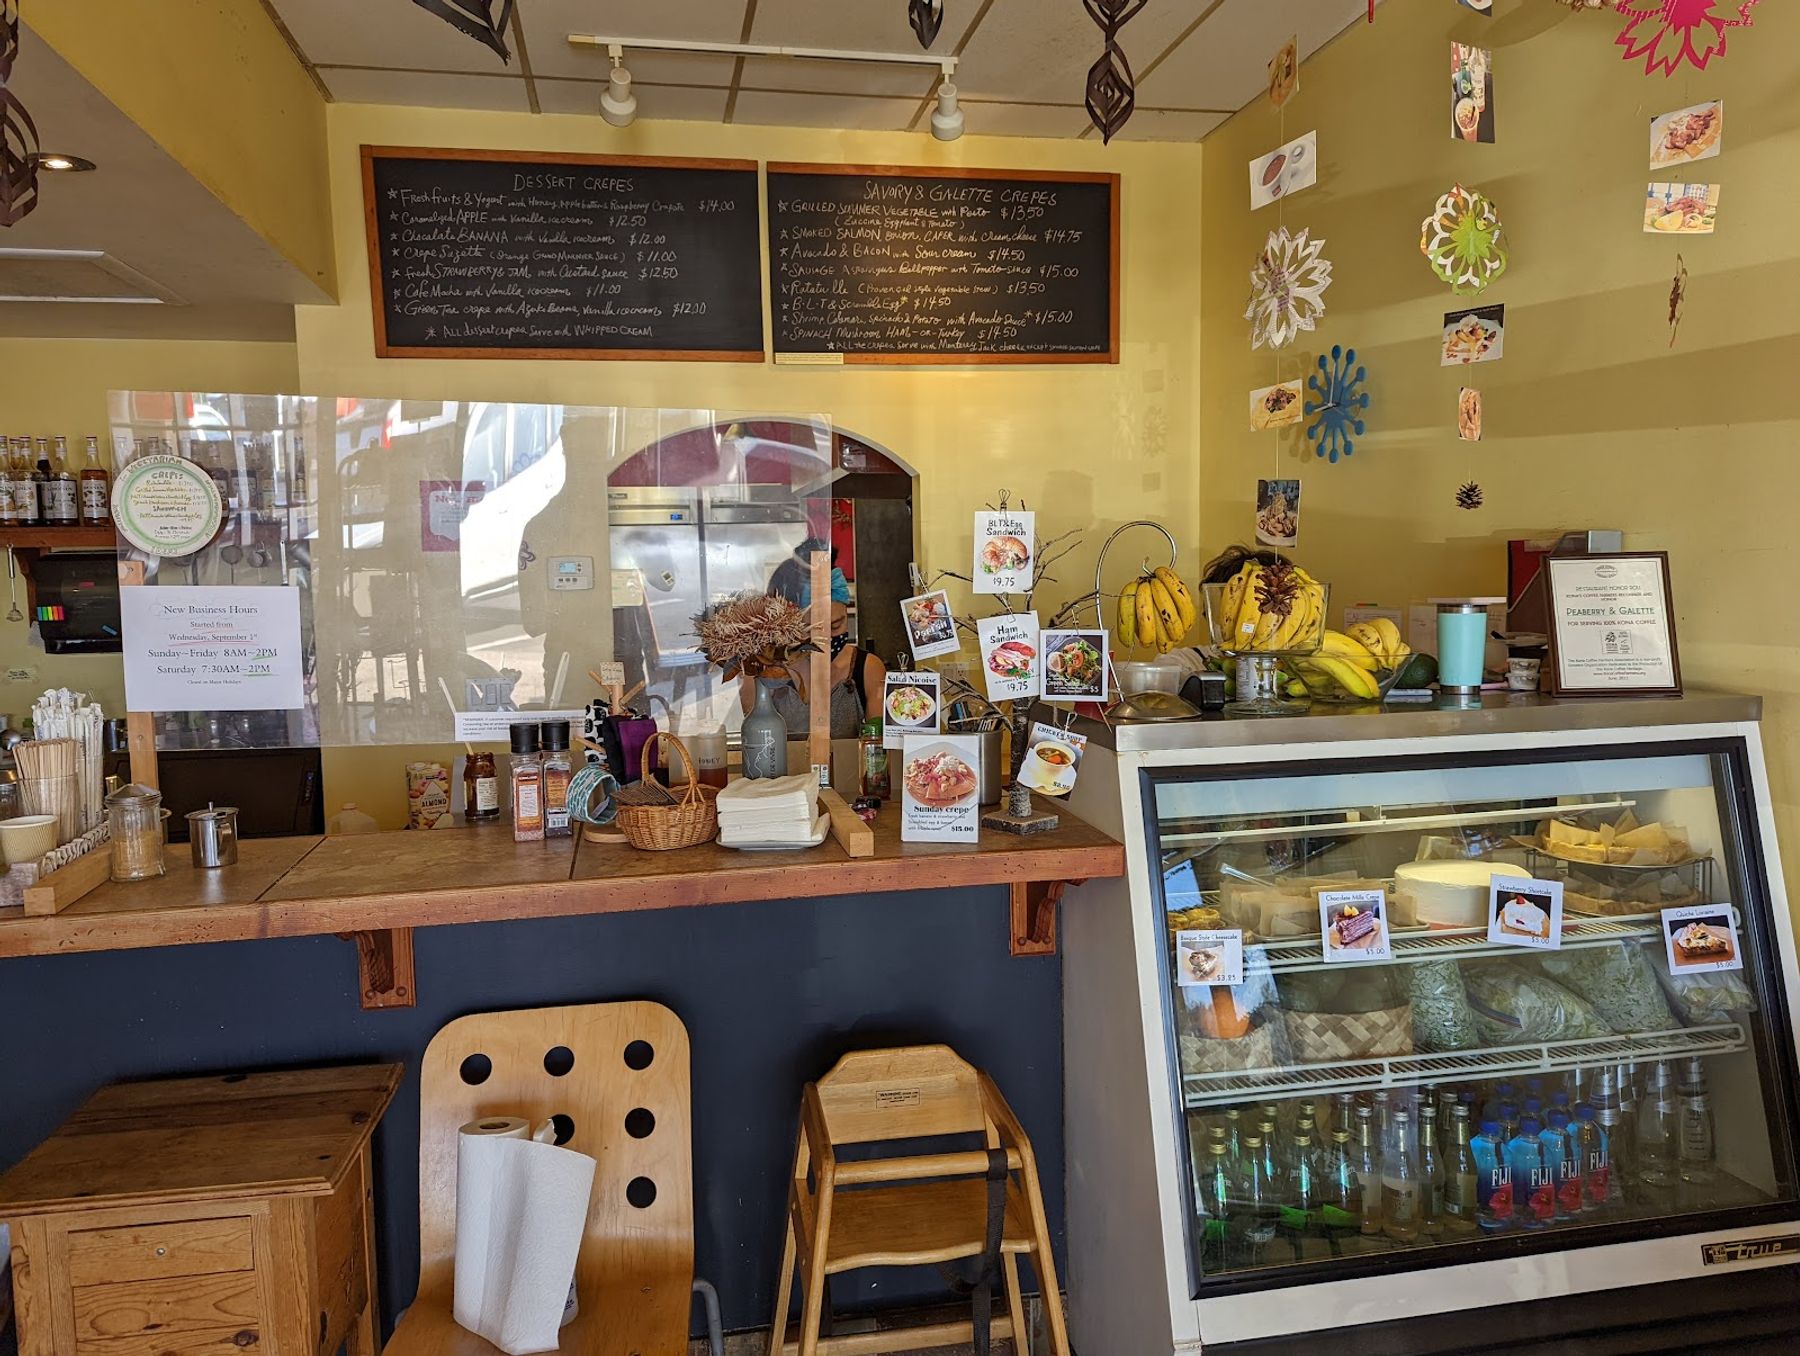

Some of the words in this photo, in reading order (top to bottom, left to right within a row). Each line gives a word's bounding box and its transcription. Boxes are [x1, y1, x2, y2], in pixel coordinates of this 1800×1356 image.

[514, 174, 575, 191] DESSERT
[584, 177, 634, 192] CREPES
[864, 181, 913, 204] SAVORY
[915, 185, 923, 197] &
[930, 185, 992, 202] GALETTE
[1000, 189, 1057, 205] CREPES
[463, 193, 472, 205] &
[698, 200, 734, 212] $14.00
[791, 199, 835, 213] GRILLED
[837, 203, 880, 215] SUMMER
[883, 206, 939, 218] VEGETABLE
[1001, 206, 1044, 221] $13.50
[456, 211, 488, 224] APPLE
[609, 215, 646, 227] $12.50
[457, 225, 508, 243] BANANA
[630, 233, 665, 245] $12.00
[793, 227, 832, 240] SMOKED
[1045, 230, 1082, 243] $14.75
[637, 251, 677, 262] $11.00
[839, 242, 848, 257] &
[853, 243, 890, 257] BACON
[988, 247, 1025, 261] $14.50
[638, 267, 679, 280] $12.50
[788, 263, 835, 277] SAUSAGE
[1040, 265, 1079, 278] $15.00
[586, 284, 621, 297] $11.00
[1007, 282, 1045, 295] $13.50
[672, 302, 706, 317] $12.00
[827, 299, 837, 309] &
[914, 295, 951, 311] $14.50
[1035, 310, 1073, 325] $15.00
[575, 324, 618, 336] WHIPPED
[619, 324, 653, 337] CREAM
[789, 327, 832, 341] SPINACH
[977, 326, 1017, 340] $14.50
[986, 527, 1026, 536] Sandwich
[164, 605, 186, 614] New
[188, 605, 227, 614] Business
[229, 605, 258, 614] Hours
[1566, 608, 1606, 616] PEABERRY
[1609, 607, 1616, 615] &
[1619, 607, 1655, 615] GALETTE
[211, 633, 247, 642] September
[997, 625, 1018, 635] Ham
[990, 632, 1029, 644] Sandwich
[157, 665, 196, 674] Saturday
[422, 798, 447, 807] ALMOND
[914, 806, 943, 814] Sunday
[1590, 1152, 1608, 1170] FIJI
[1492, 1167, 1511, 1186] FIJI
[1560, 1160, 1580, 1178] FIJI
[1531, 1168, 1553, 1186] FIJI
